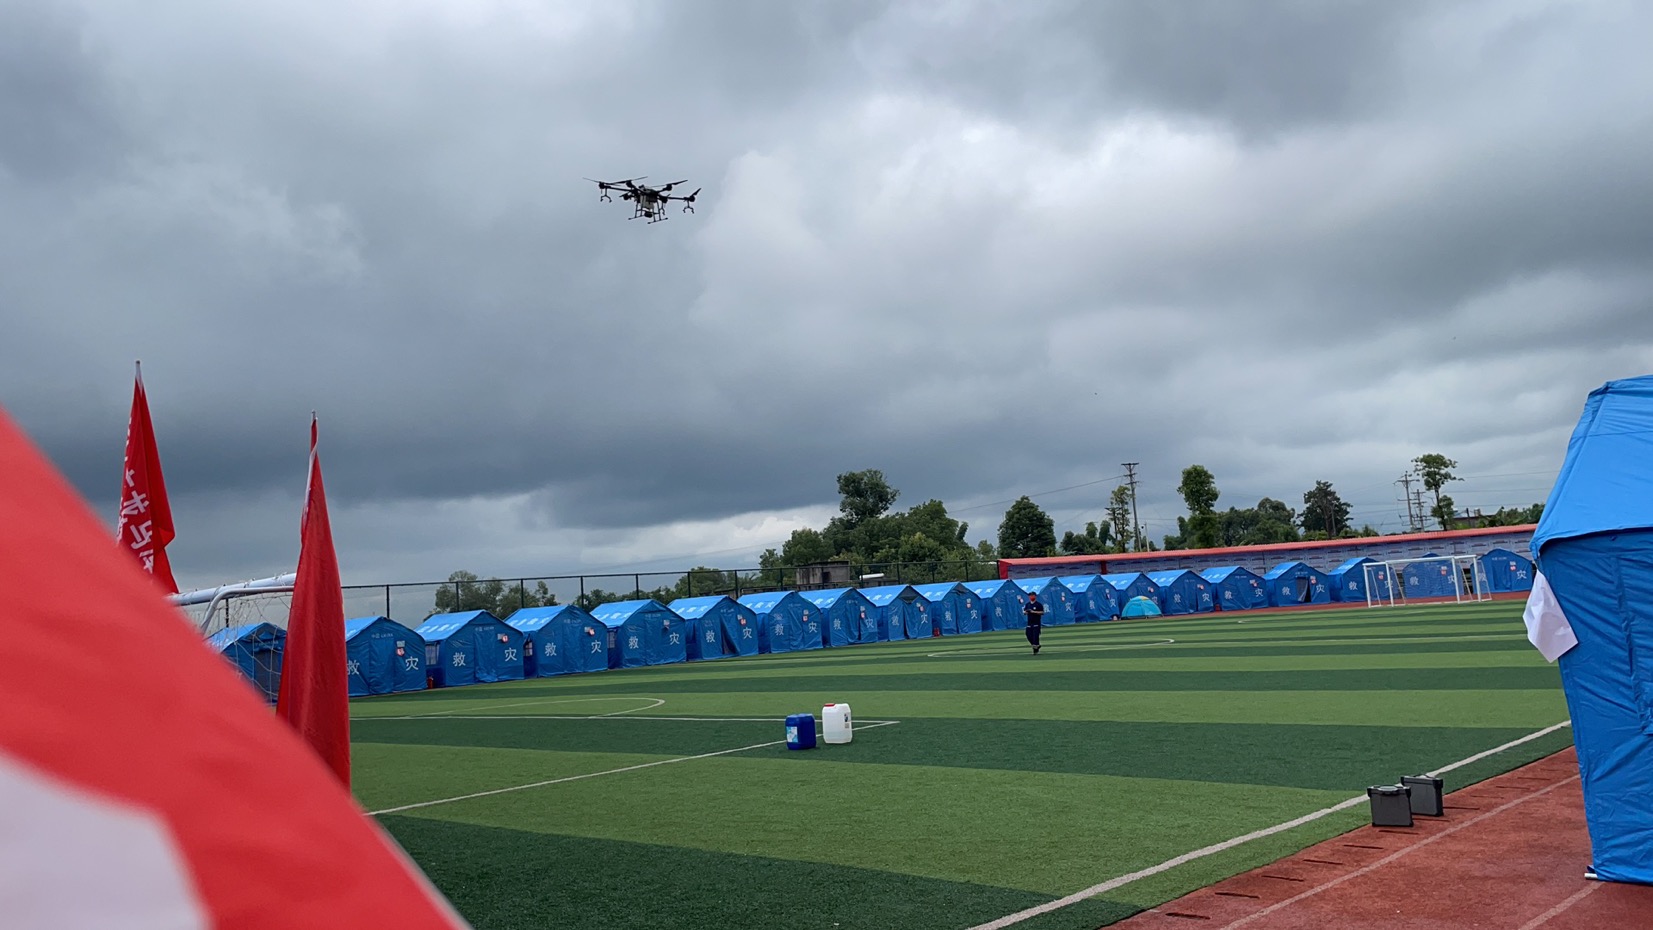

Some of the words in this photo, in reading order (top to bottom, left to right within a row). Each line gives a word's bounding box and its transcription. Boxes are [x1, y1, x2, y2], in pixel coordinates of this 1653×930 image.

[1516, 569, 1527, 580] 灾
[1254, 588, 1264, 597] 灾
[1316, 584, 1325, 593] 灾
[1202, 592, 1211, 602] 灾
[970, 608, 978, 619] 灾
[774, 623, 784, 636] 救
[808, 621, 818, 633] 灾
[864, 616, 874, 628] 灾
[628, 635, 639, 649] 救
[669, 632, 680, 645] 灾
[705, 629, 716, 643] 救
[742, 626, 753, 639] 灾
[544, 641, 557, 657] 救
[590, 639, 602, 654] 灾
[405, 655, 419, 671] 灾
[452, 651, 466, 667] 救
[504, 647, 518, 662] 灾
